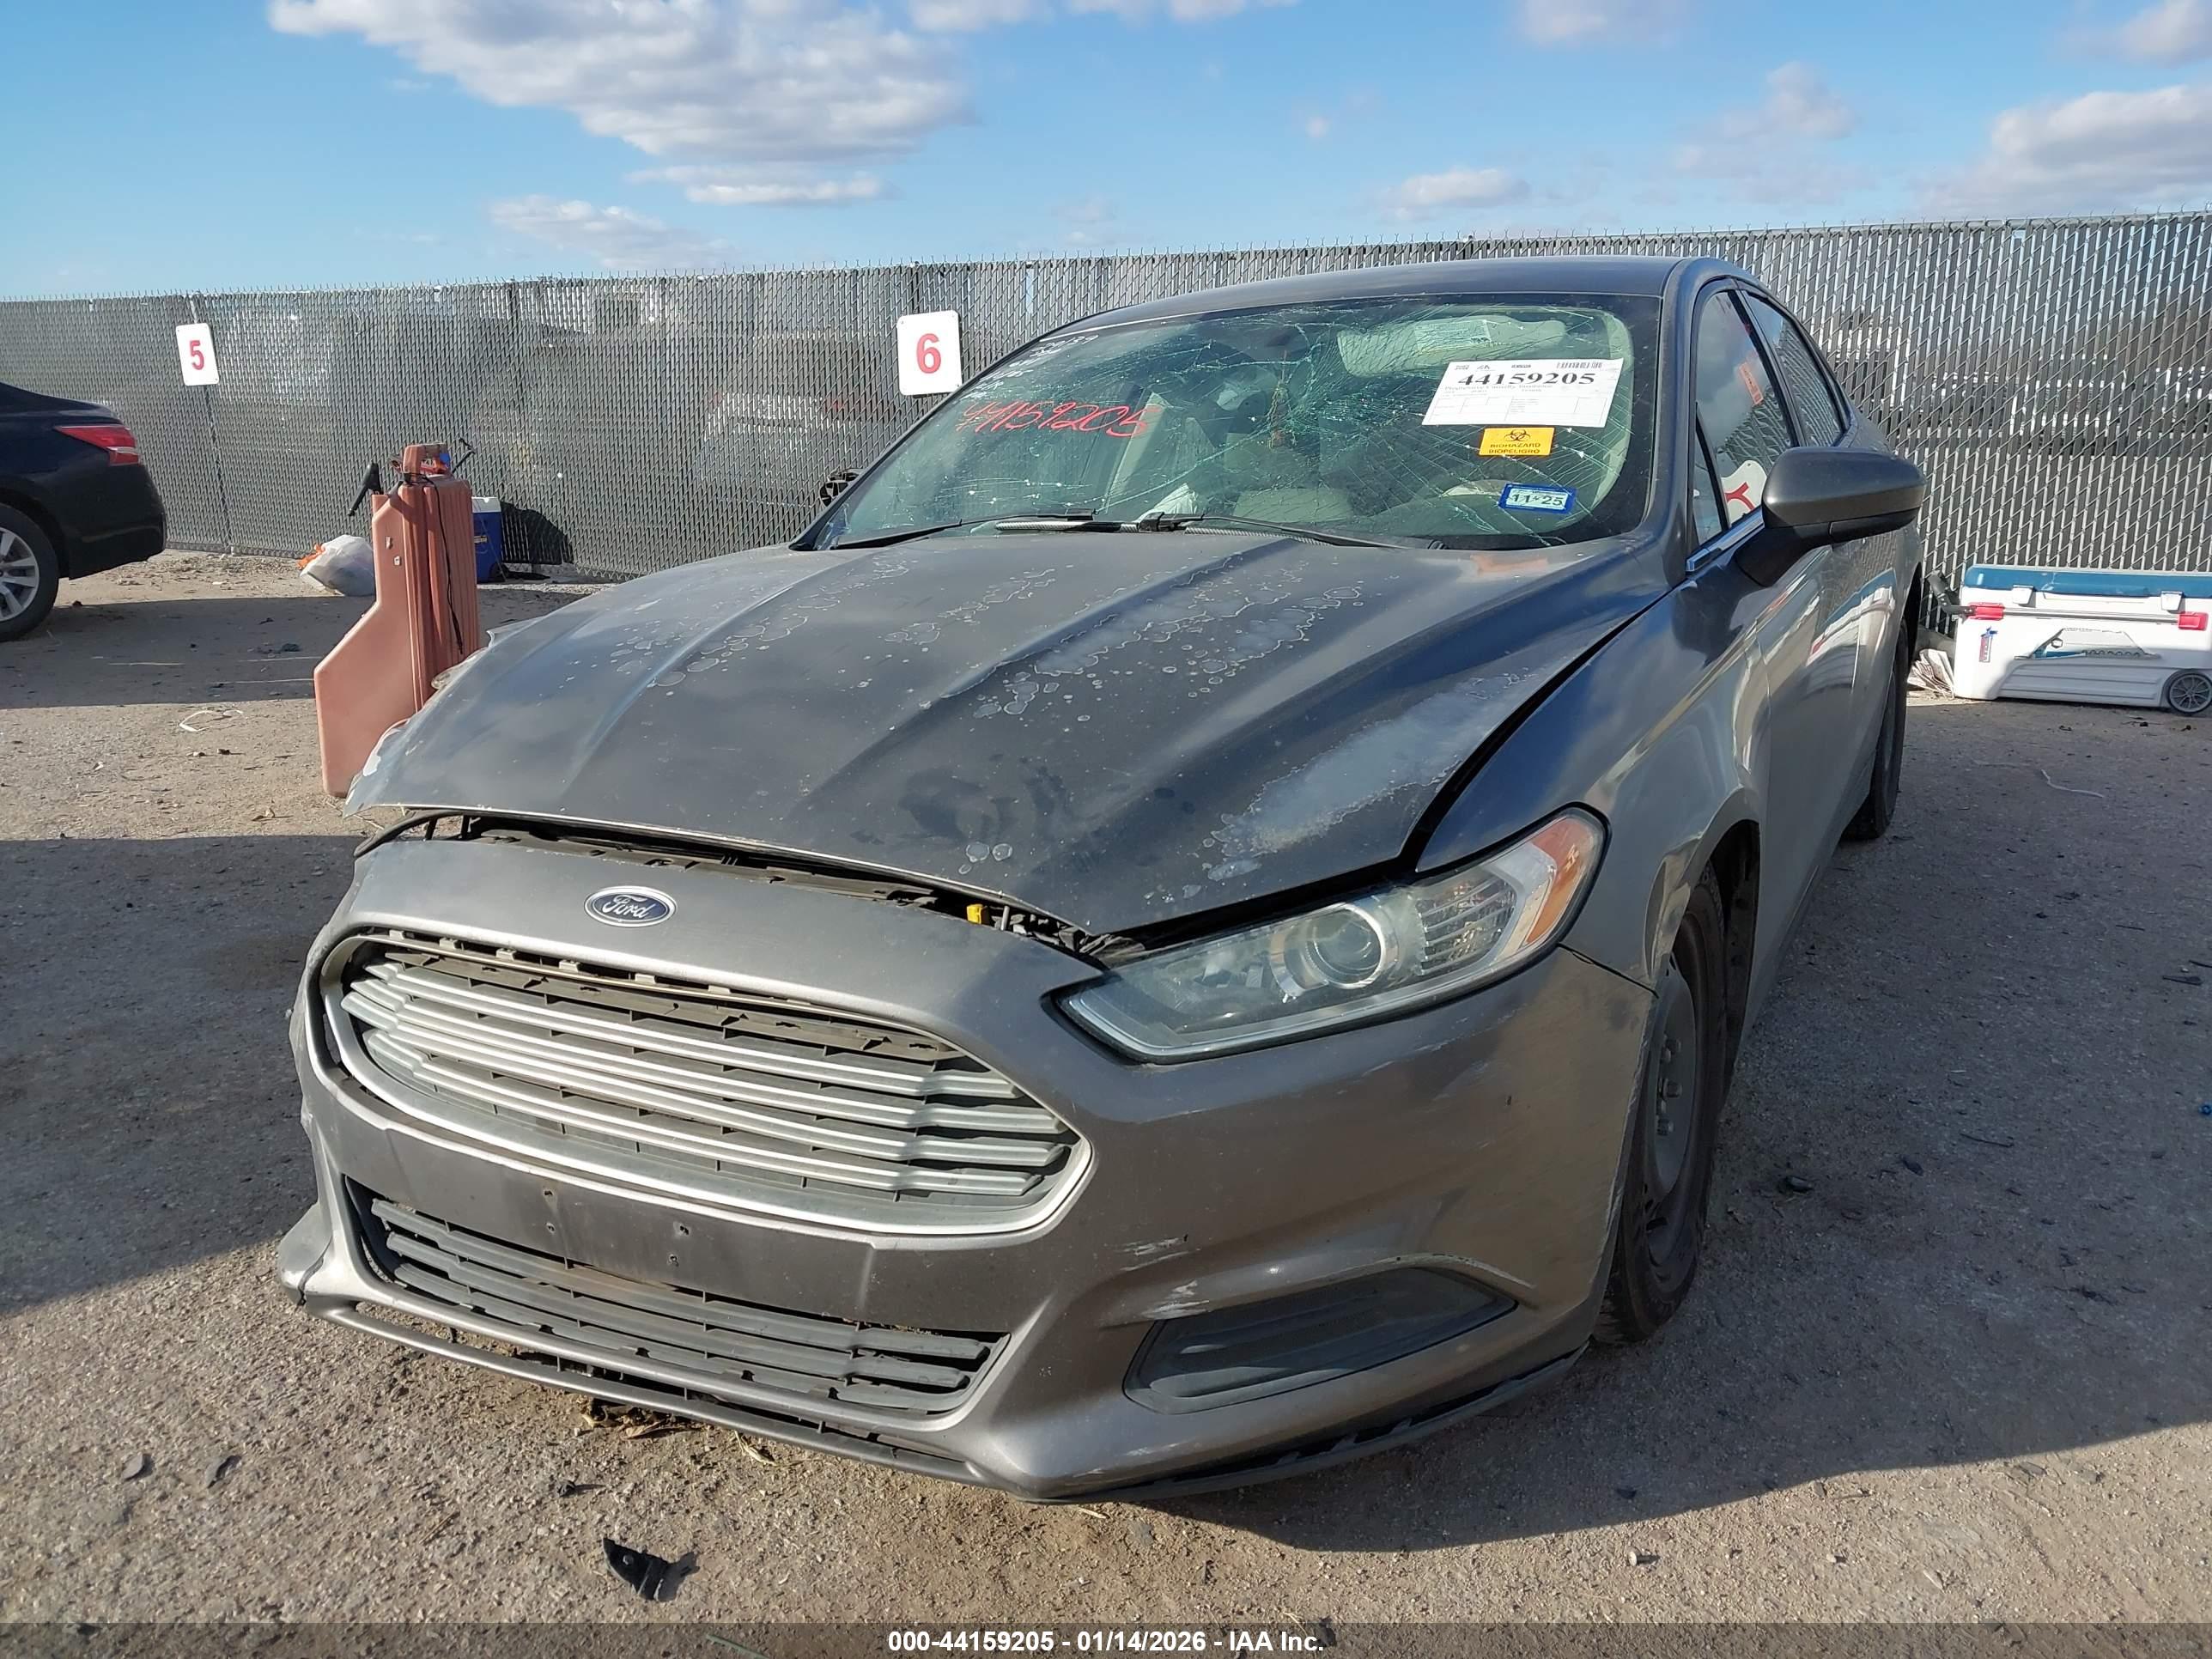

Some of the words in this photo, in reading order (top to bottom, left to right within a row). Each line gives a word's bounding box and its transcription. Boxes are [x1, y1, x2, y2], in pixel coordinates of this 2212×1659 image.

[190, 339, 204, 370] 5
[915, 332, 942, 374] 6
[1457, 372, 1595, 386] 44159205
[955, 400, 1159, 437] 44159205
[1511, 494, 1530, 503] 11
[1541, 496, 1564, 506] 25
[602, 894, 656, 918] Ford
